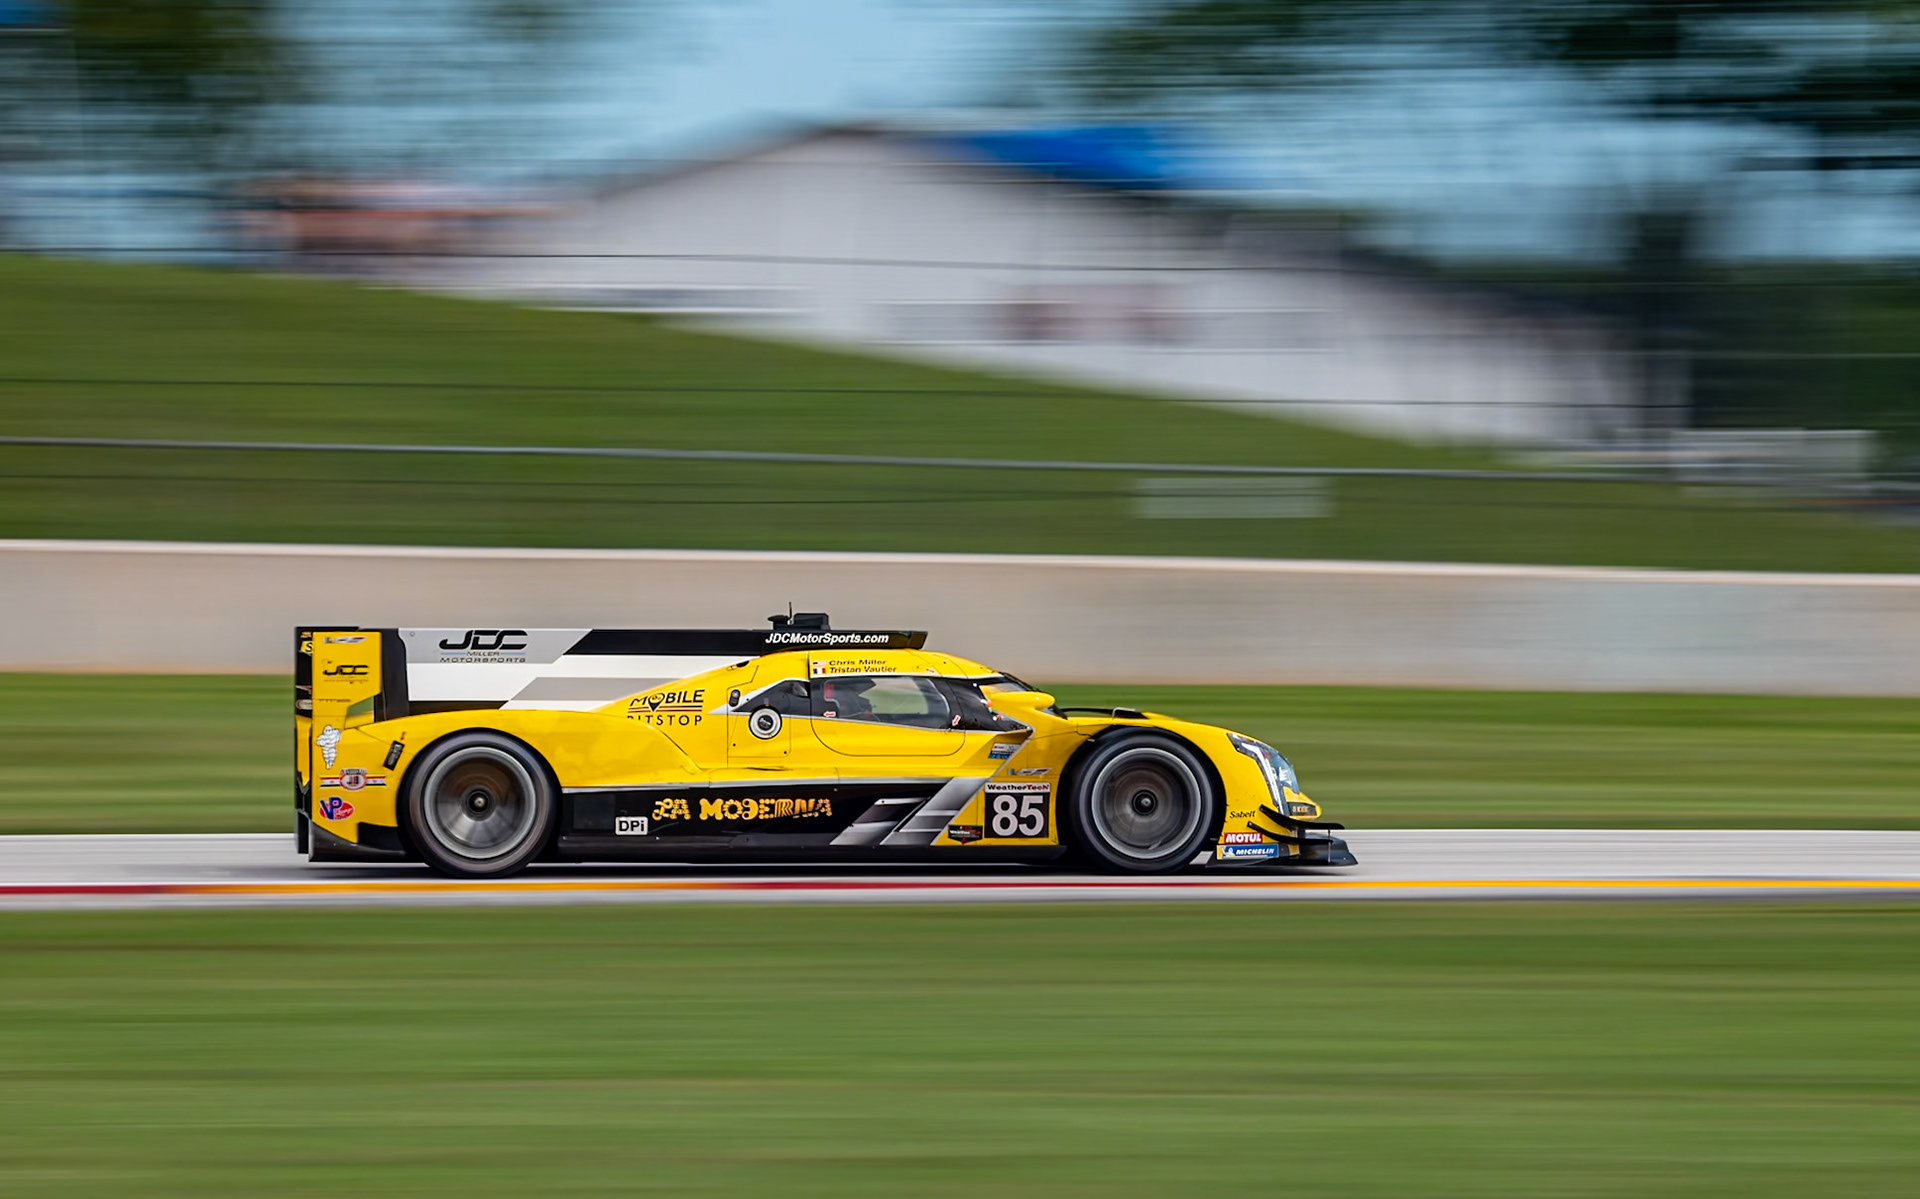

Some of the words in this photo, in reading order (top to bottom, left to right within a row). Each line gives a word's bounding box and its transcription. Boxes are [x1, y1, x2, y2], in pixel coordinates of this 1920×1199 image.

[438, 629, 528, 650] JDC
[765, 633, 889, 645] JDCMotorSports.com
[323, 664, 369, 675] JDC
[629, 689, 705, 707] MOBILE
[320, 797, 343, 820] VP
[652, 798, 691, 820] LA
[699, 798, 832, 820] MODERNA
[992, 794, 1044, 836] 85
[619, 820, 645, 832] DPi
[1225, 834, 1262, 843] MOTUL
